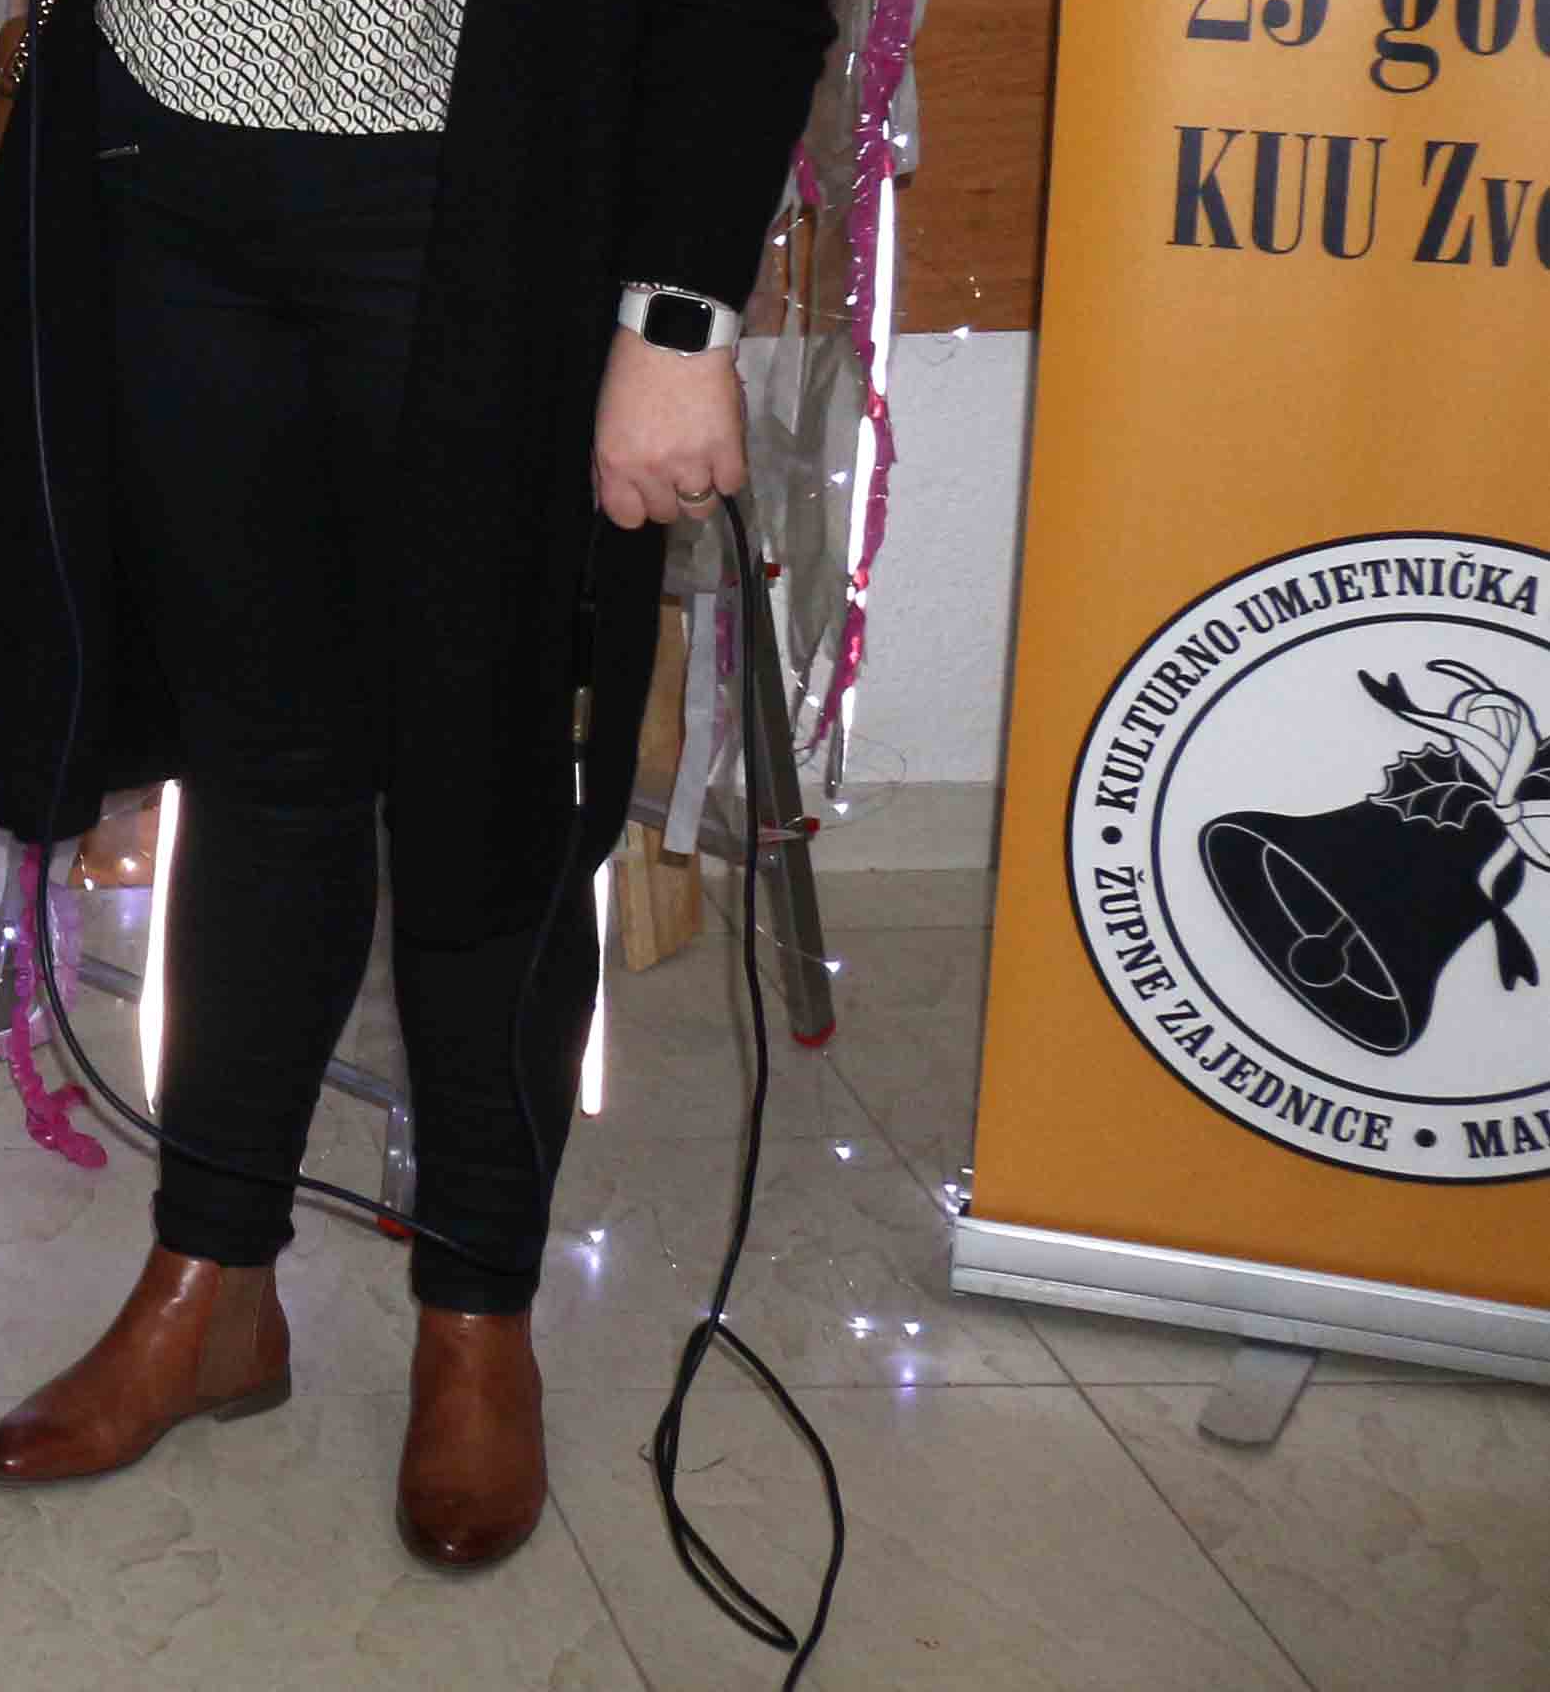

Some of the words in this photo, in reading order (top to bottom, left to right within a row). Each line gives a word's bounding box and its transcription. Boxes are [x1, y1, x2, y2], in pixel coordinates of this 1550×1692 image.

[1167, 125, 1388, 259] KUU
[1413, 140, 1550, 271] Zv
[1094, 551, 1540, 814] KULTURNO-UMJETNIČKA
[1094, 865, 1178, 1001] ŽUPNE
[1156, 999, 1393, 1152] ZAJEDNICE
